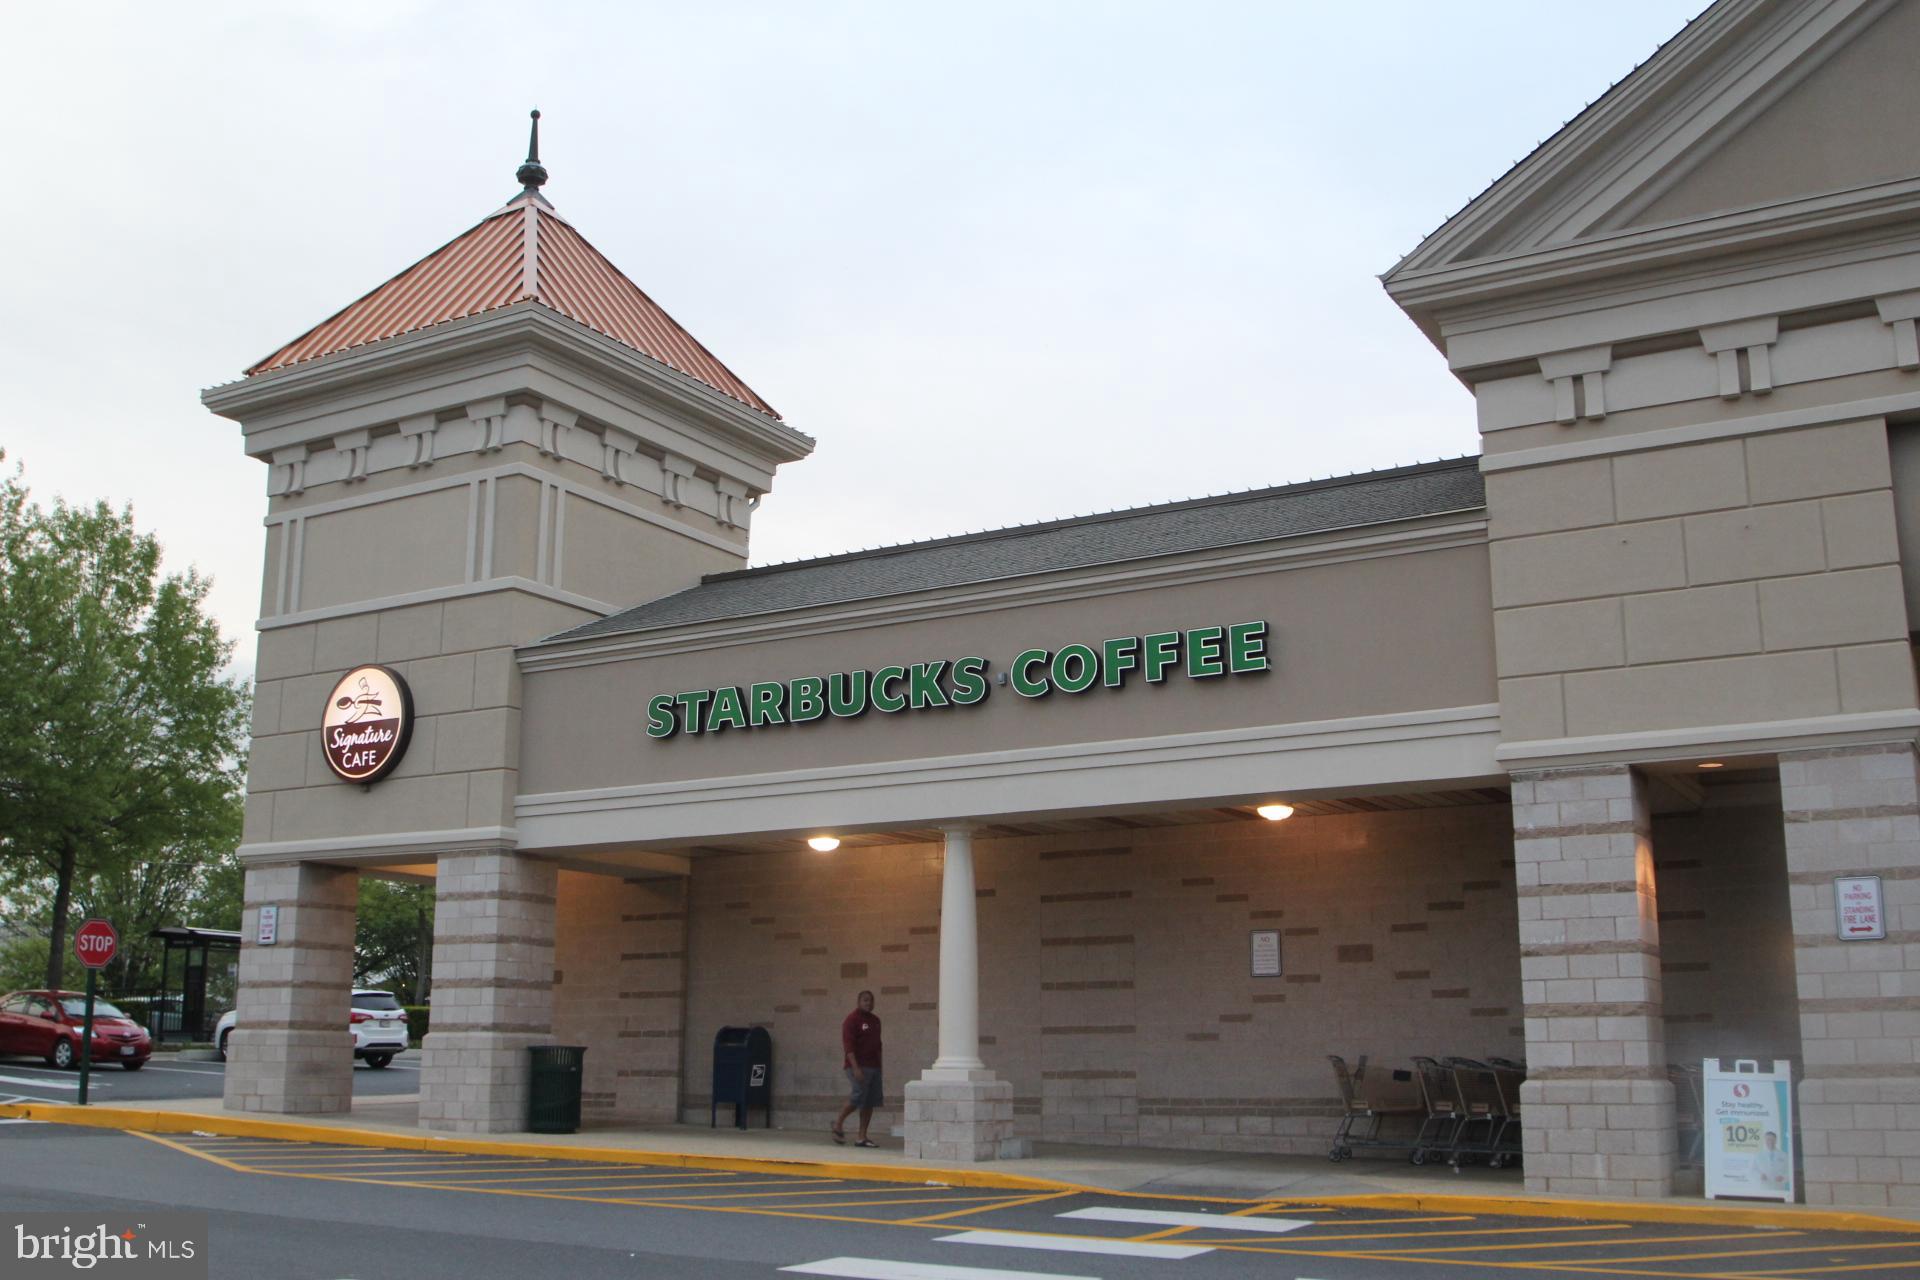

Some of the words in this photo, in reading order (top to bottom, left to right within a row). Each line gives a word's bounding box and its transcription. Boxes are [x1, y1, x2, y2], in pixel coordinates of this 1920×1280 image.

[645, 655, 989, 739] STARBUCKS
[1009, 619, 1270, 699] COFFEE
[330, 725, 393, 753] Signature
[342, 750, 377, 769] CAFE
[1843, 892, 1872, 900] PARKING
[1852, 884, 1863, 892] NO
[1843, 905, 1875, 914] STANDING
[1859, 913, 1877, 923] LANE
[80, 934, 113, 952] STOP
[1726, 1125, 1760, 1142] 10%
